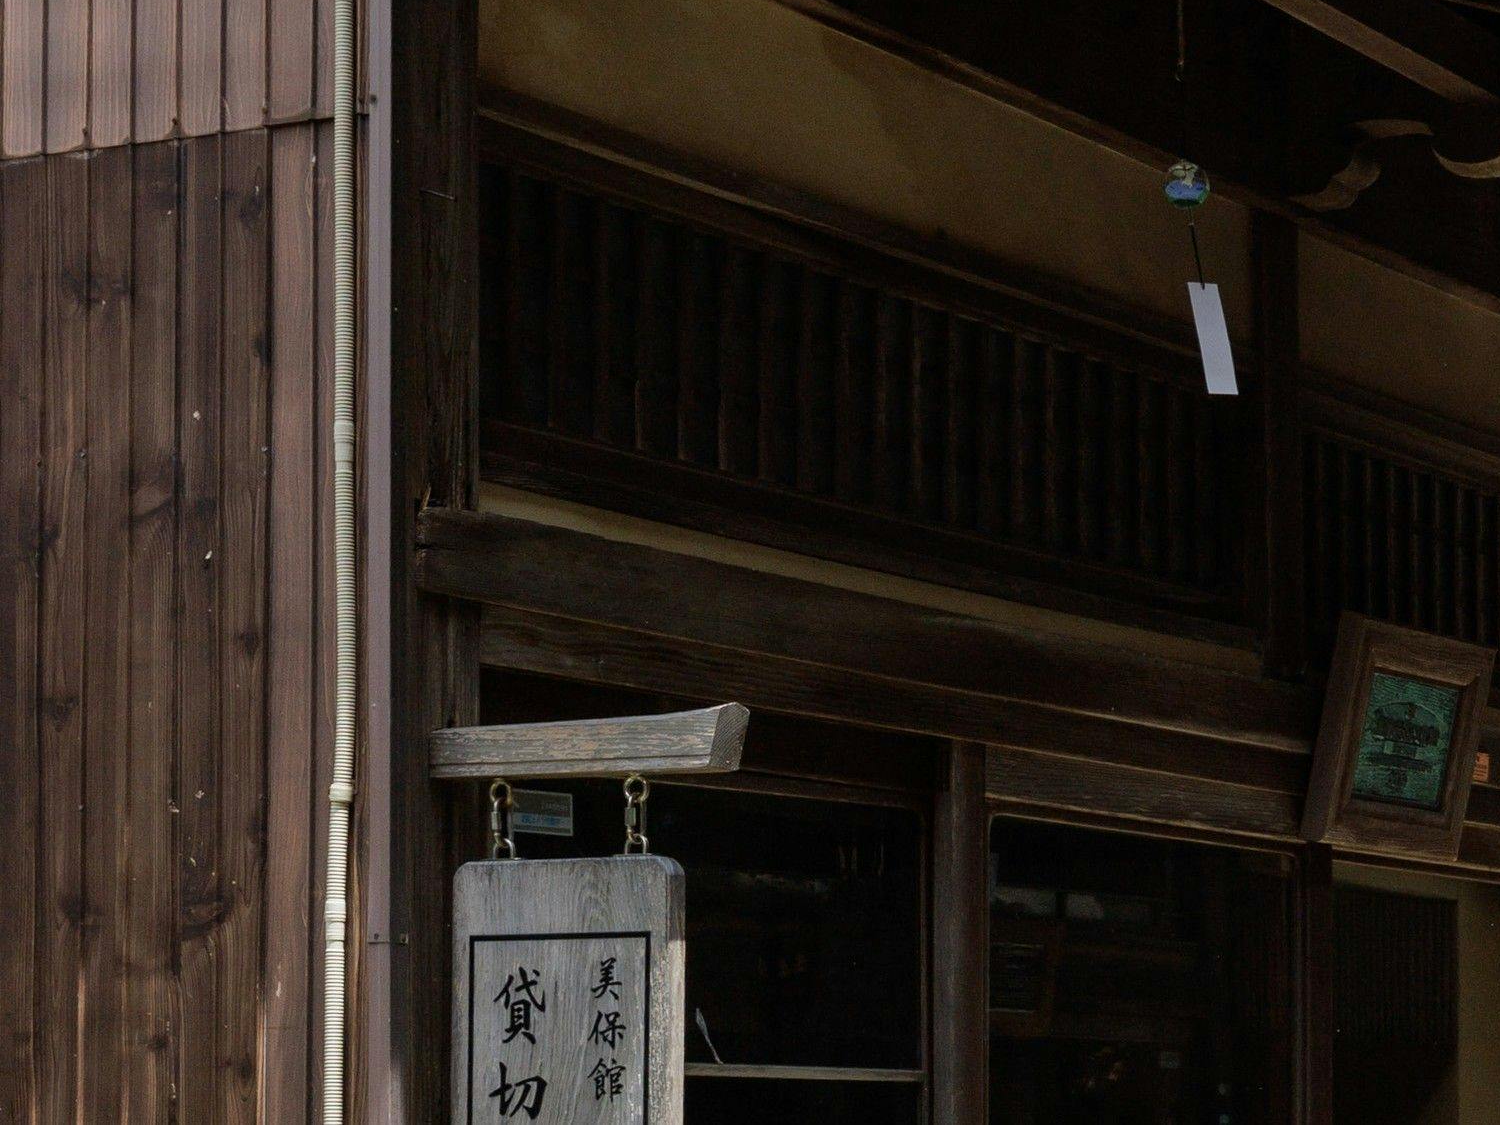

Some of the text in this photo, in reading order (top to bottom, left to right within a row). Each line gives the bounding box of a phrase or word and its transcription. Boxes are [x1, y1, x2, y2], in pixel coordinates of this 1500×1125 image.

[489, 966, 546, 1120] 貸切
[588, 957, 627, 1102] 美保館
